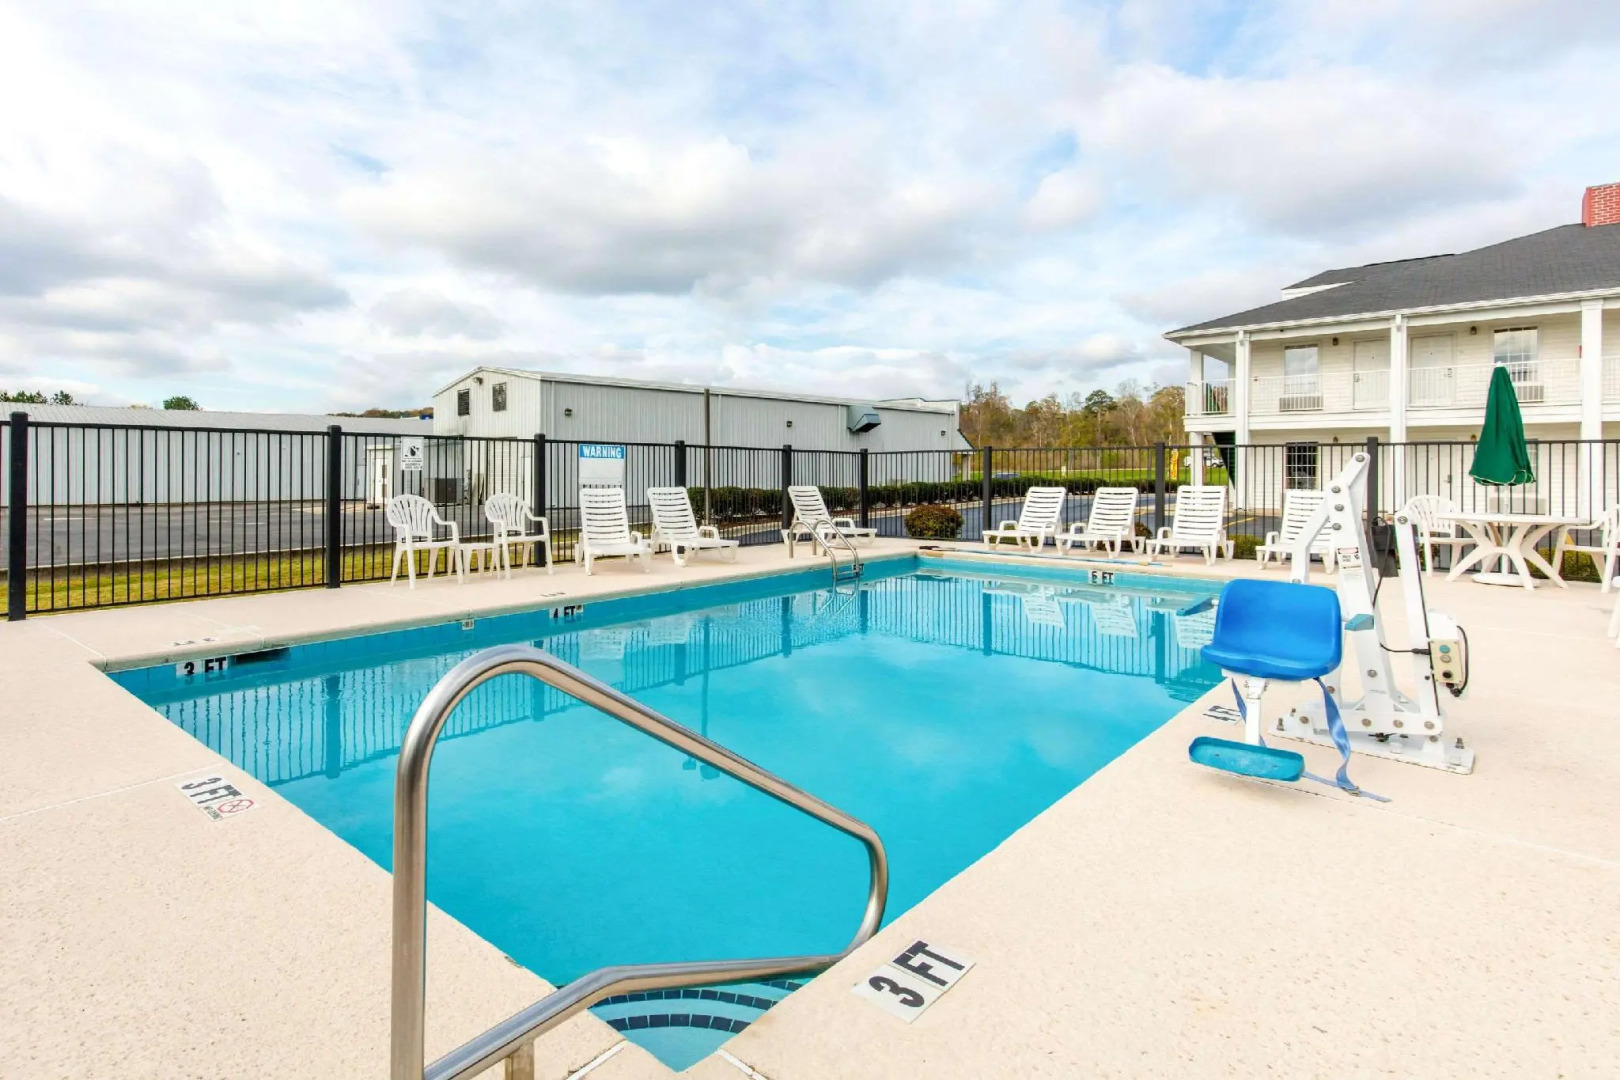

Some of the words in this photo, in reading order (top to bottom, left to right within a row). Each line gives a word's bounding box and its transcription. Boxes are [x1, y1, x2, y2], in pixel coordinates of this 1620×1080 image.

[583, 445, 622, 459] WARNING
[564, 605, 576, 617] FT
[184, 661, 195, 675] 3
[205, 656, 227, 673] FT
[181, 777, 222, 790] 3
[189, 784, 242, 804] FT
[892, 940, 965, 987] FT
[868, 975, 925, 1008] 3
